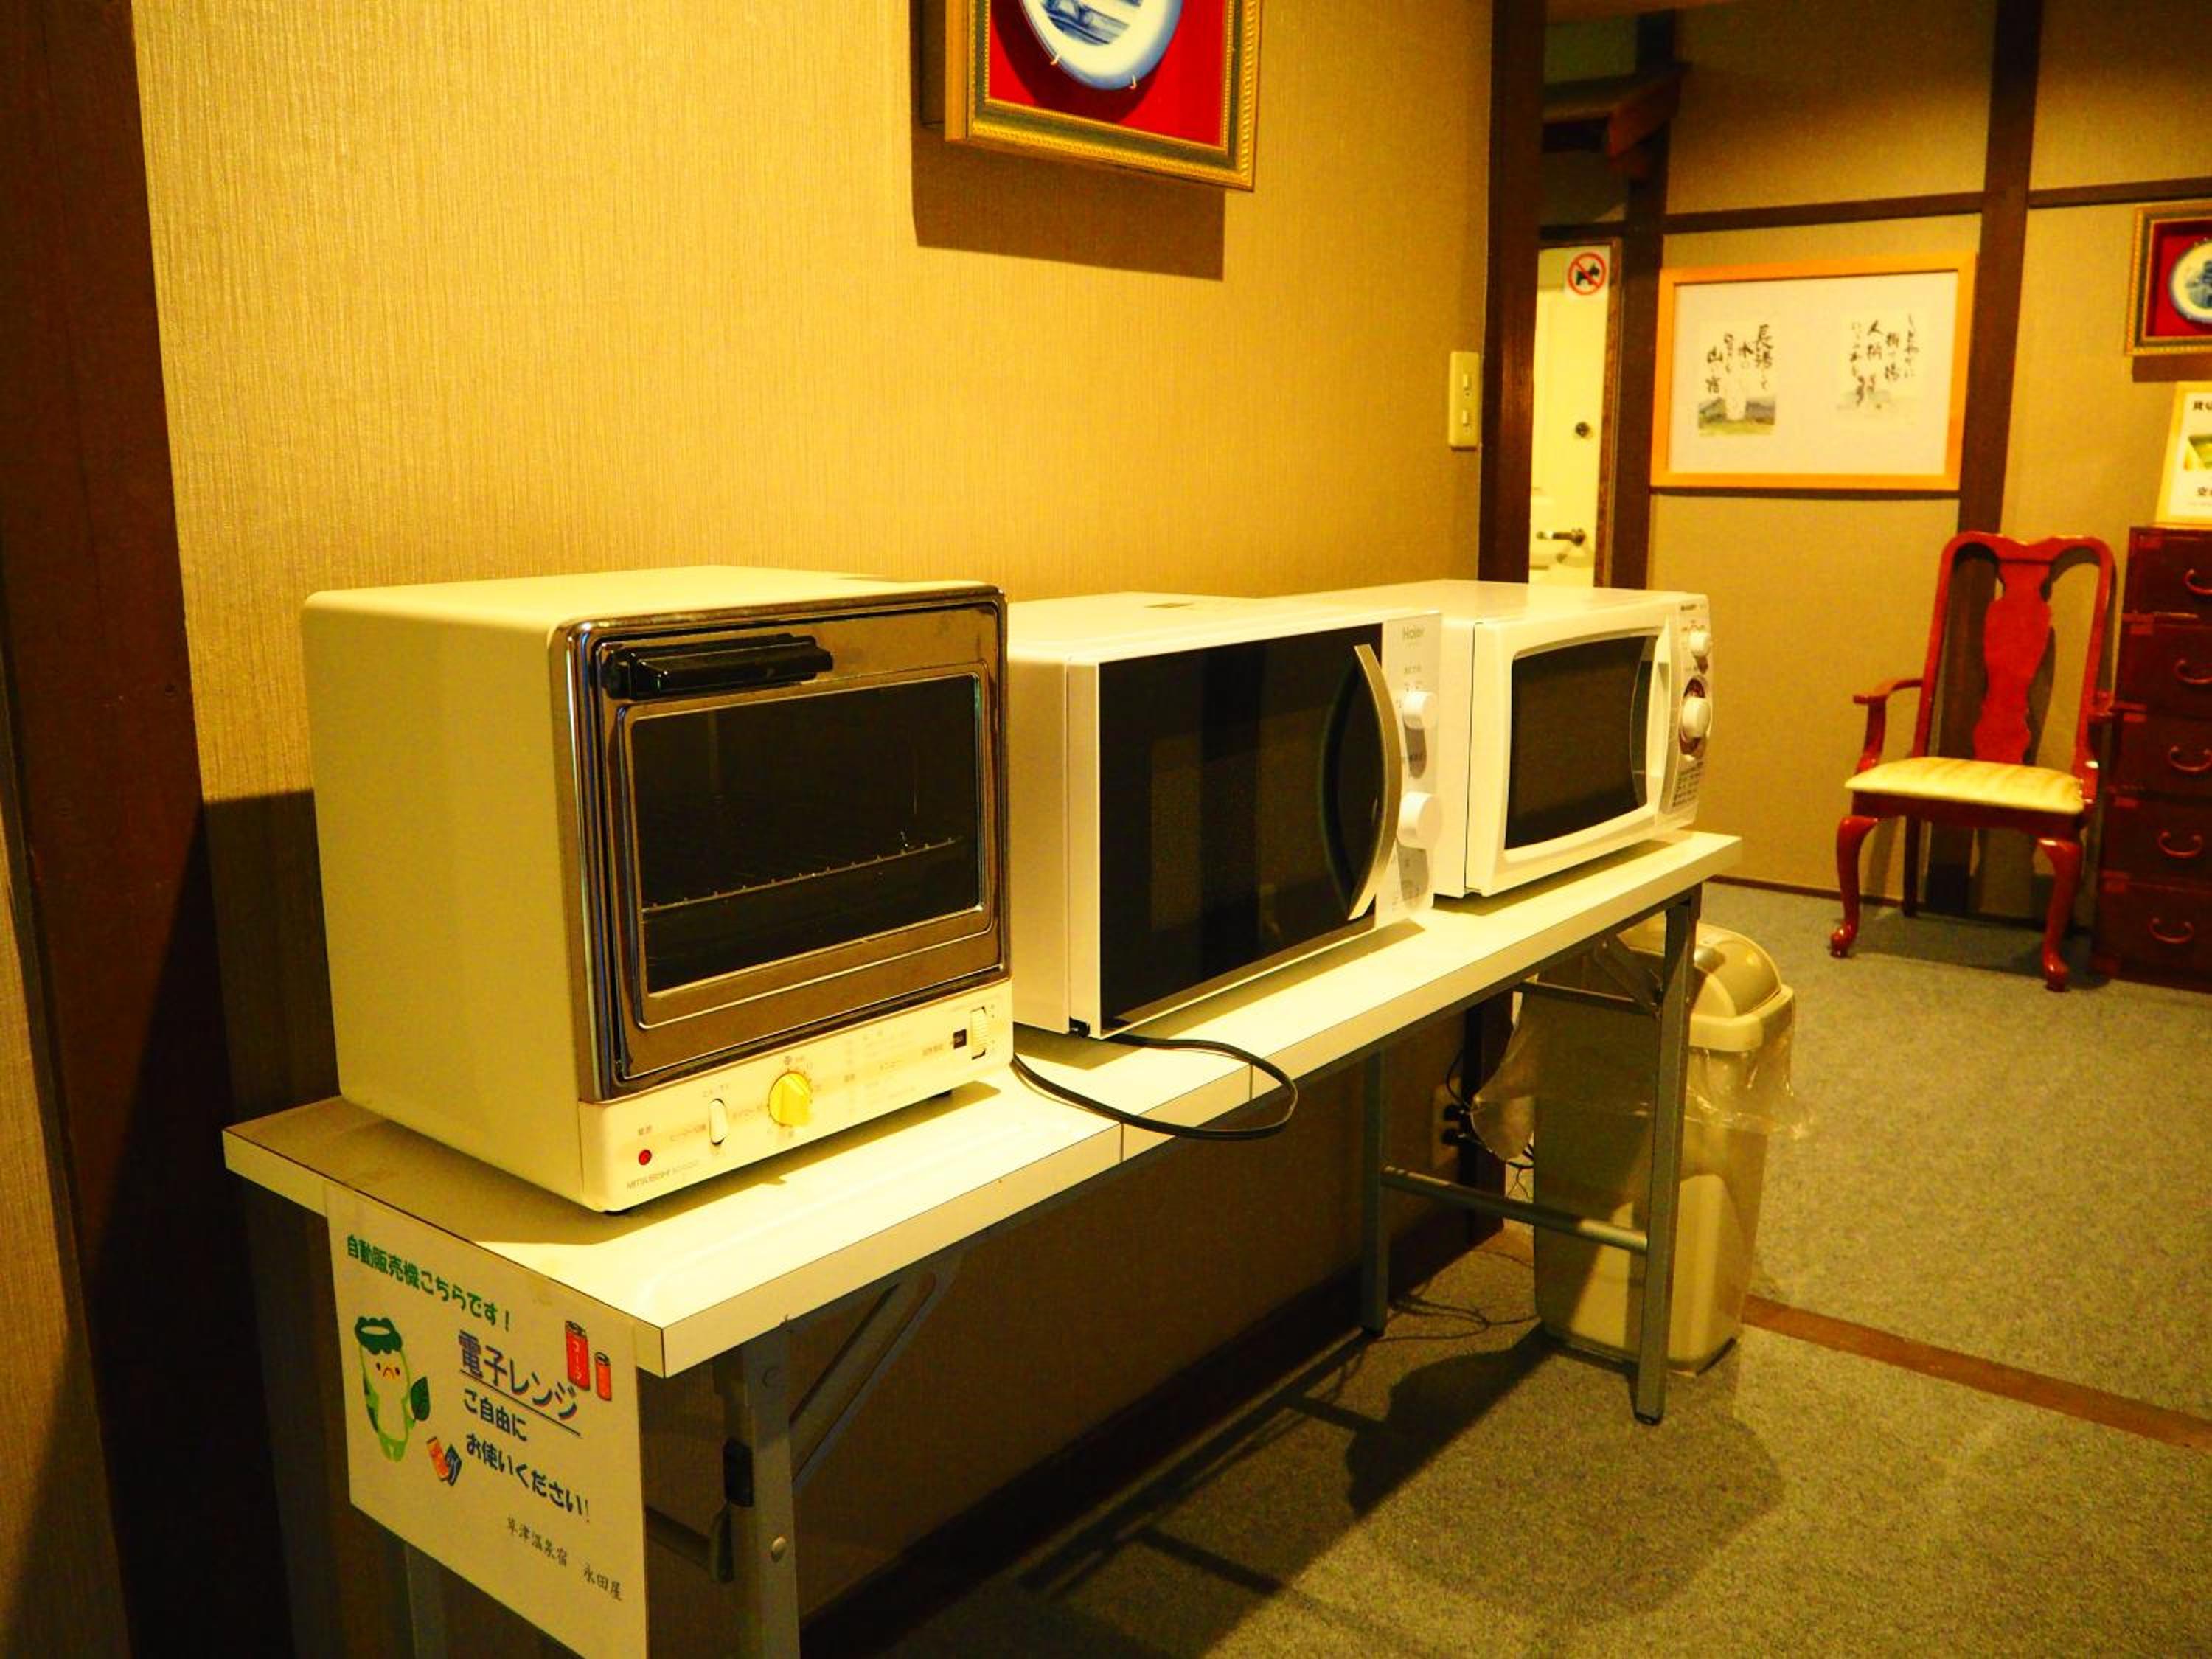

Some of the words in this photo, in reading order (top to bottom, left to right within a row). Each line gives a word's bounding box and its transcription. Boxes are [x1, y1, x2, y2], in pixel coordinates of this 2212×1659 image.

[459, 1330, 577, 1419] 電子レンジ
[464, 1388, 527, 1441] ご自由に
